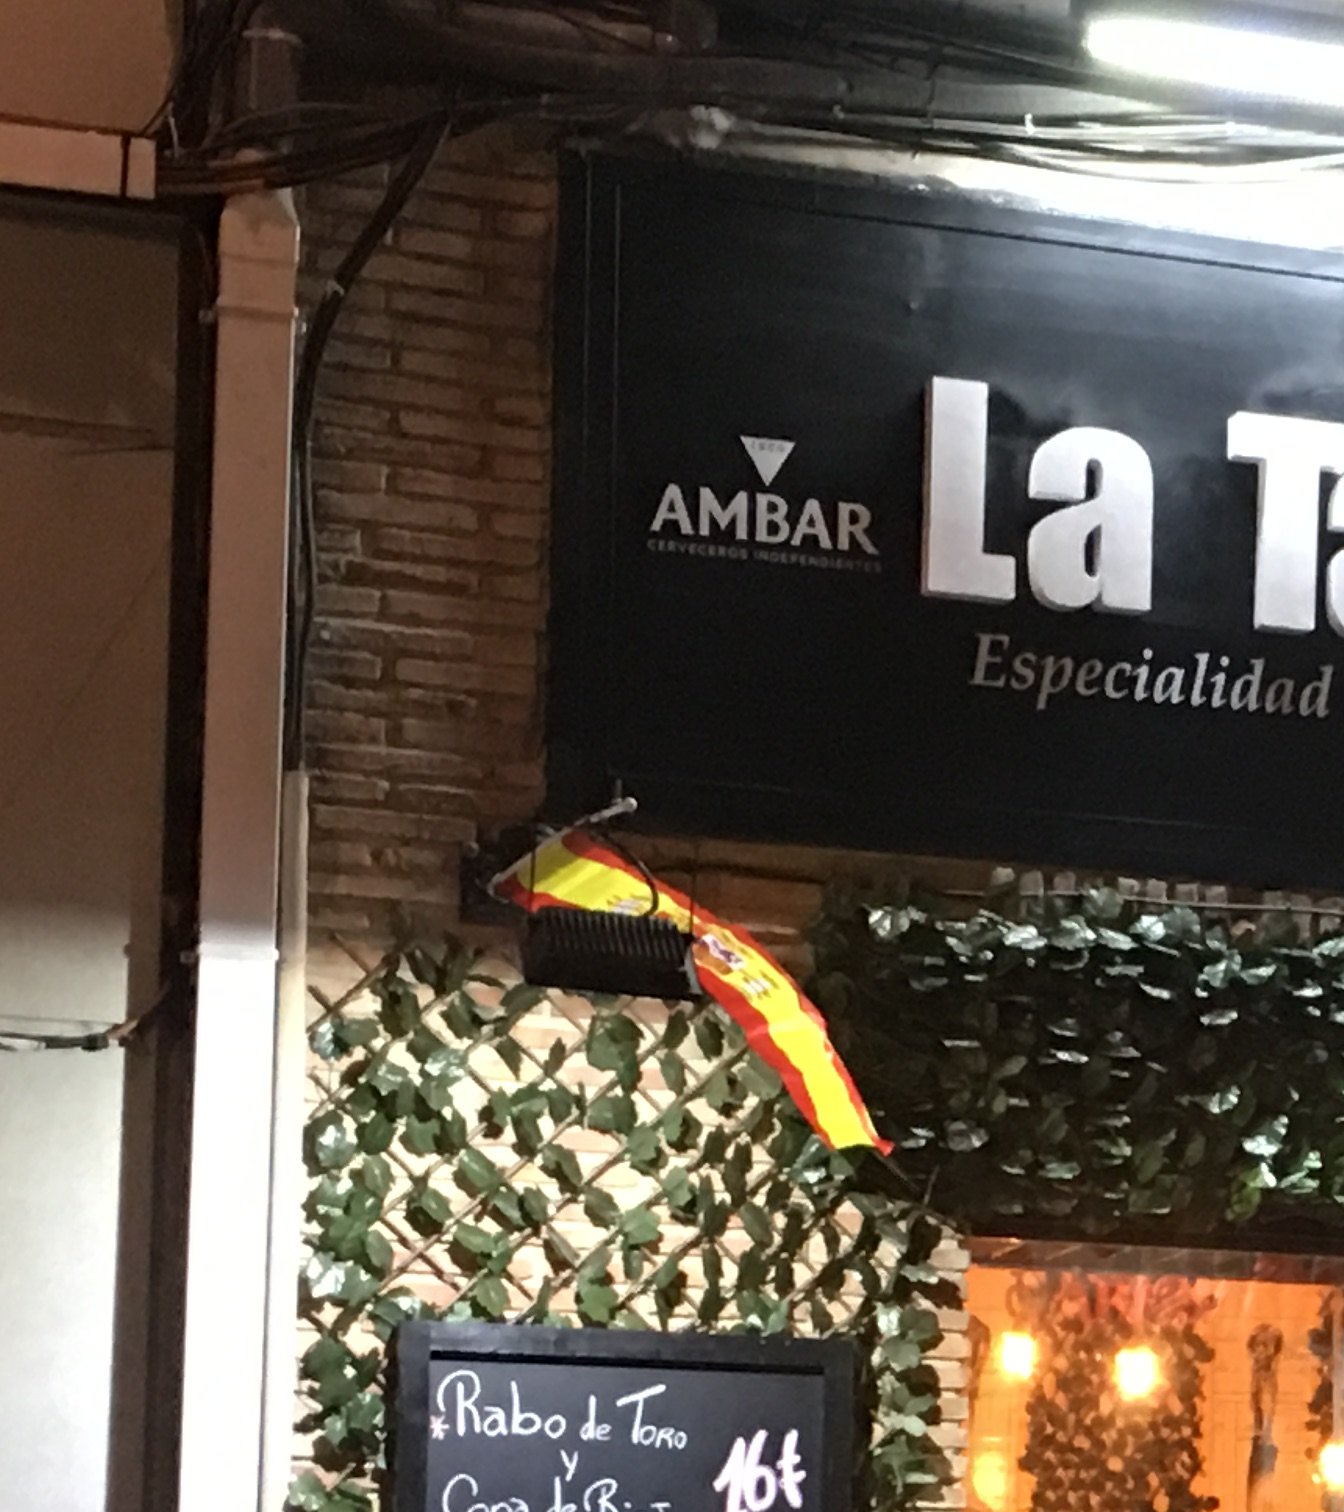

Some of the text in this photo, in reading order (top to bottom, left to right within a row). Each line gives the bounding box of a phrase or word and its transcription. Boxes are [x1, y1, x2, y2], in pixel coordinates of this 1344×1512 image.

[650, 483, 880, 556] AMBAR
[921, 375, 1154, 614] La
[646, 538, 749, 561] CERVECEROS
[968, 632, 1334, 719] Especialidad
[437, 1369, 566, 1438] Rabo
[580, 1395, 612, 1440] de
